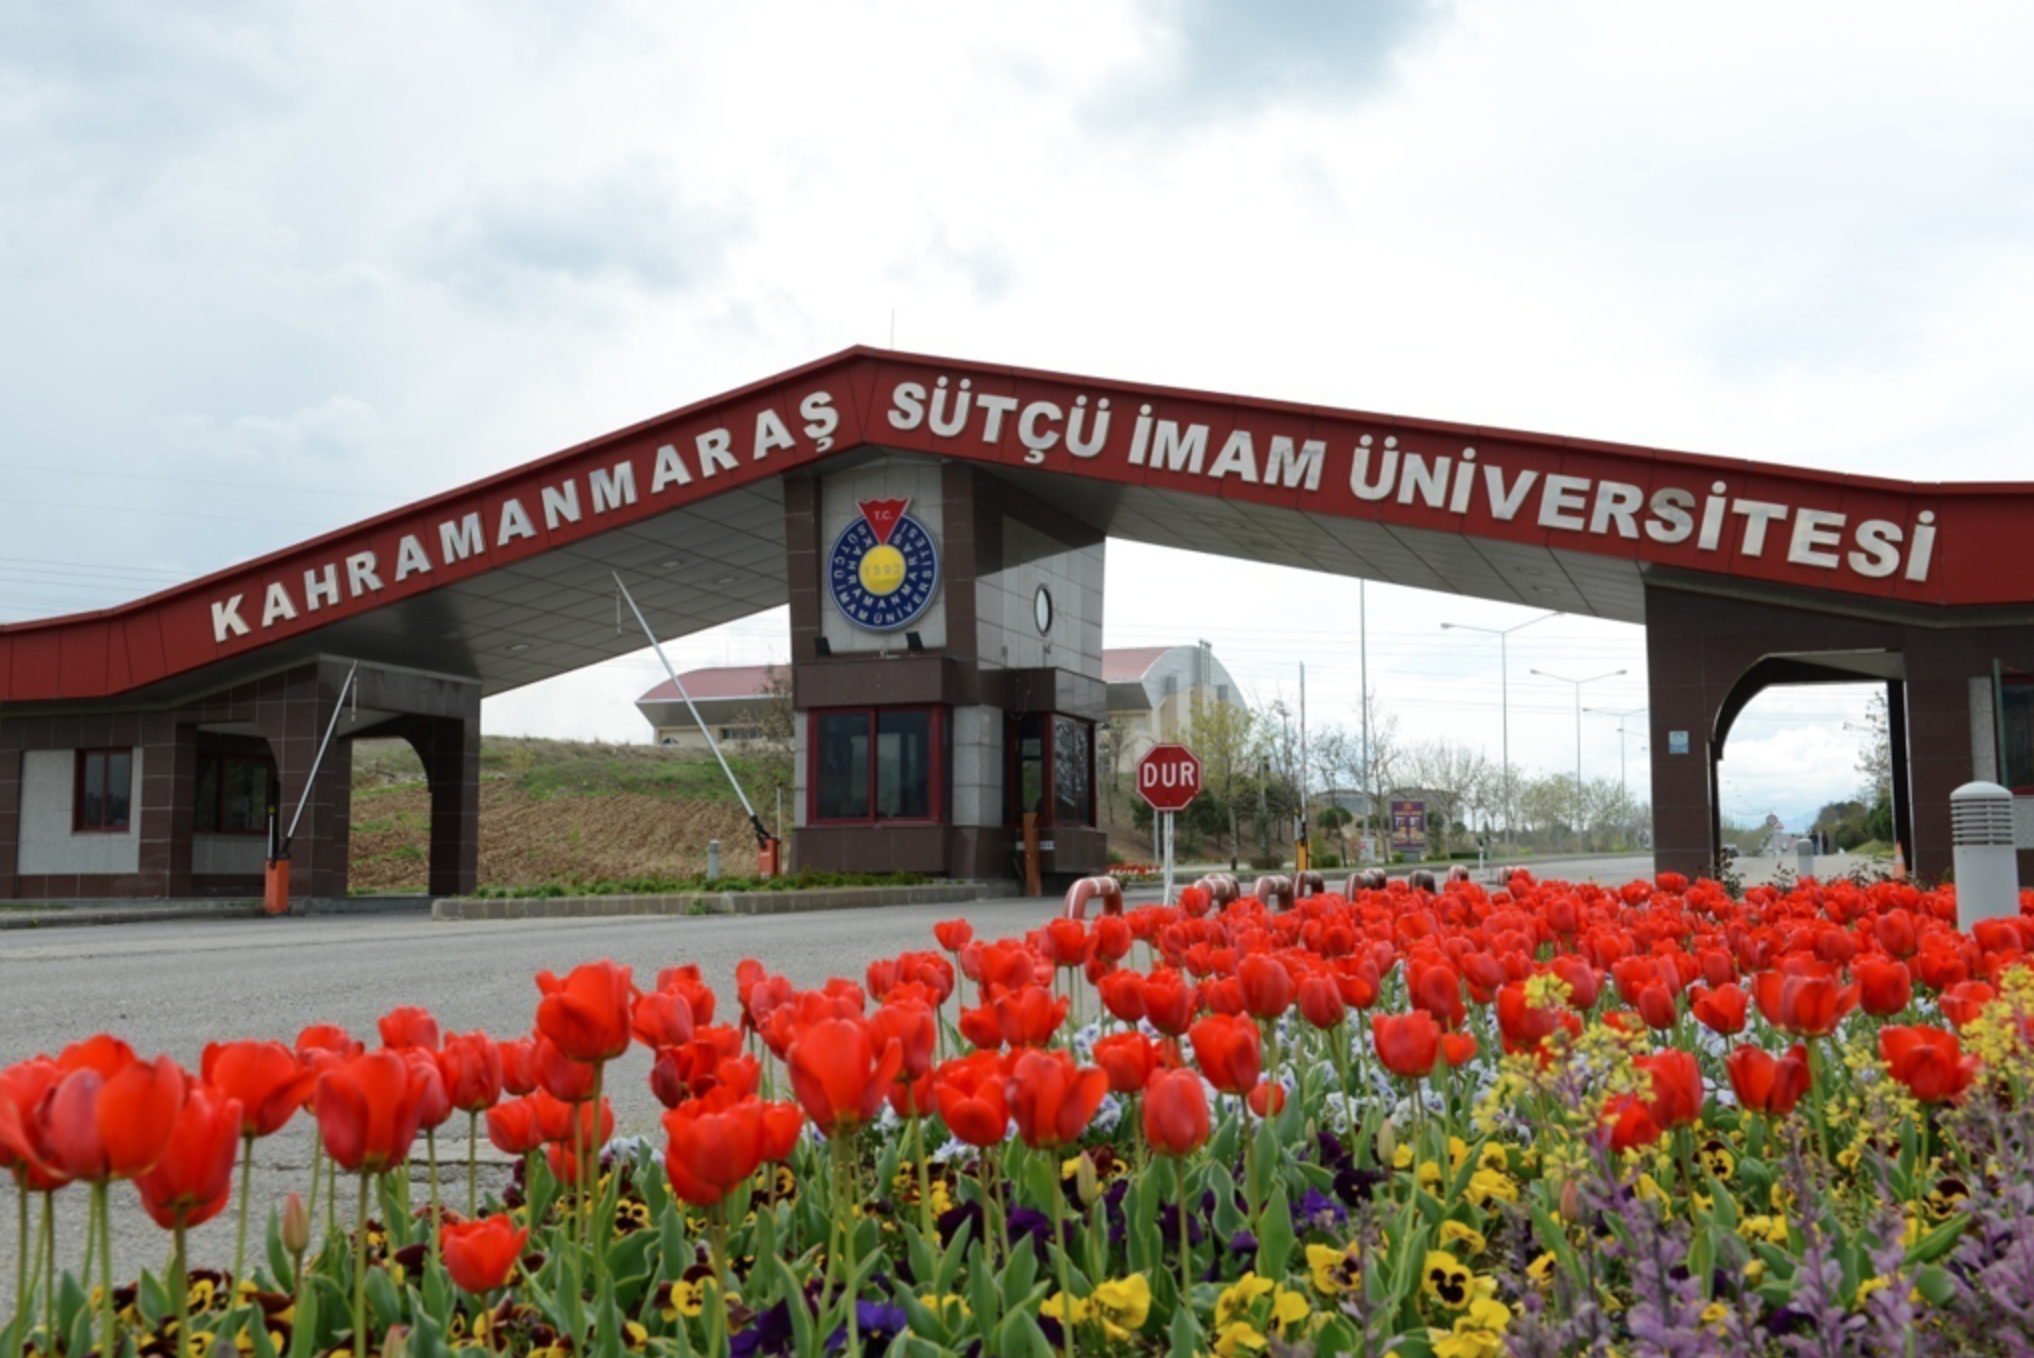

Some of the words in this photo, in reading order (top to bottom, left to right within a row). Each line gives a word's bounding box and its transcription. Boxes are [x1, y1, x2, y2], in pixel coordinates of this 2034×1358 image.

[211, 391, 840, 643] KAHRAMANMARAŞ
[887, 376, 1111, 464] SÜTÇÜ
[1128, 404, 1327, 491] İMAM
[1349, 434, 1936, 582] ÜNİVERSİTESİ
[873, 510, 894, 520] T.C.
[1143, 761, 1195, 788] DUR
